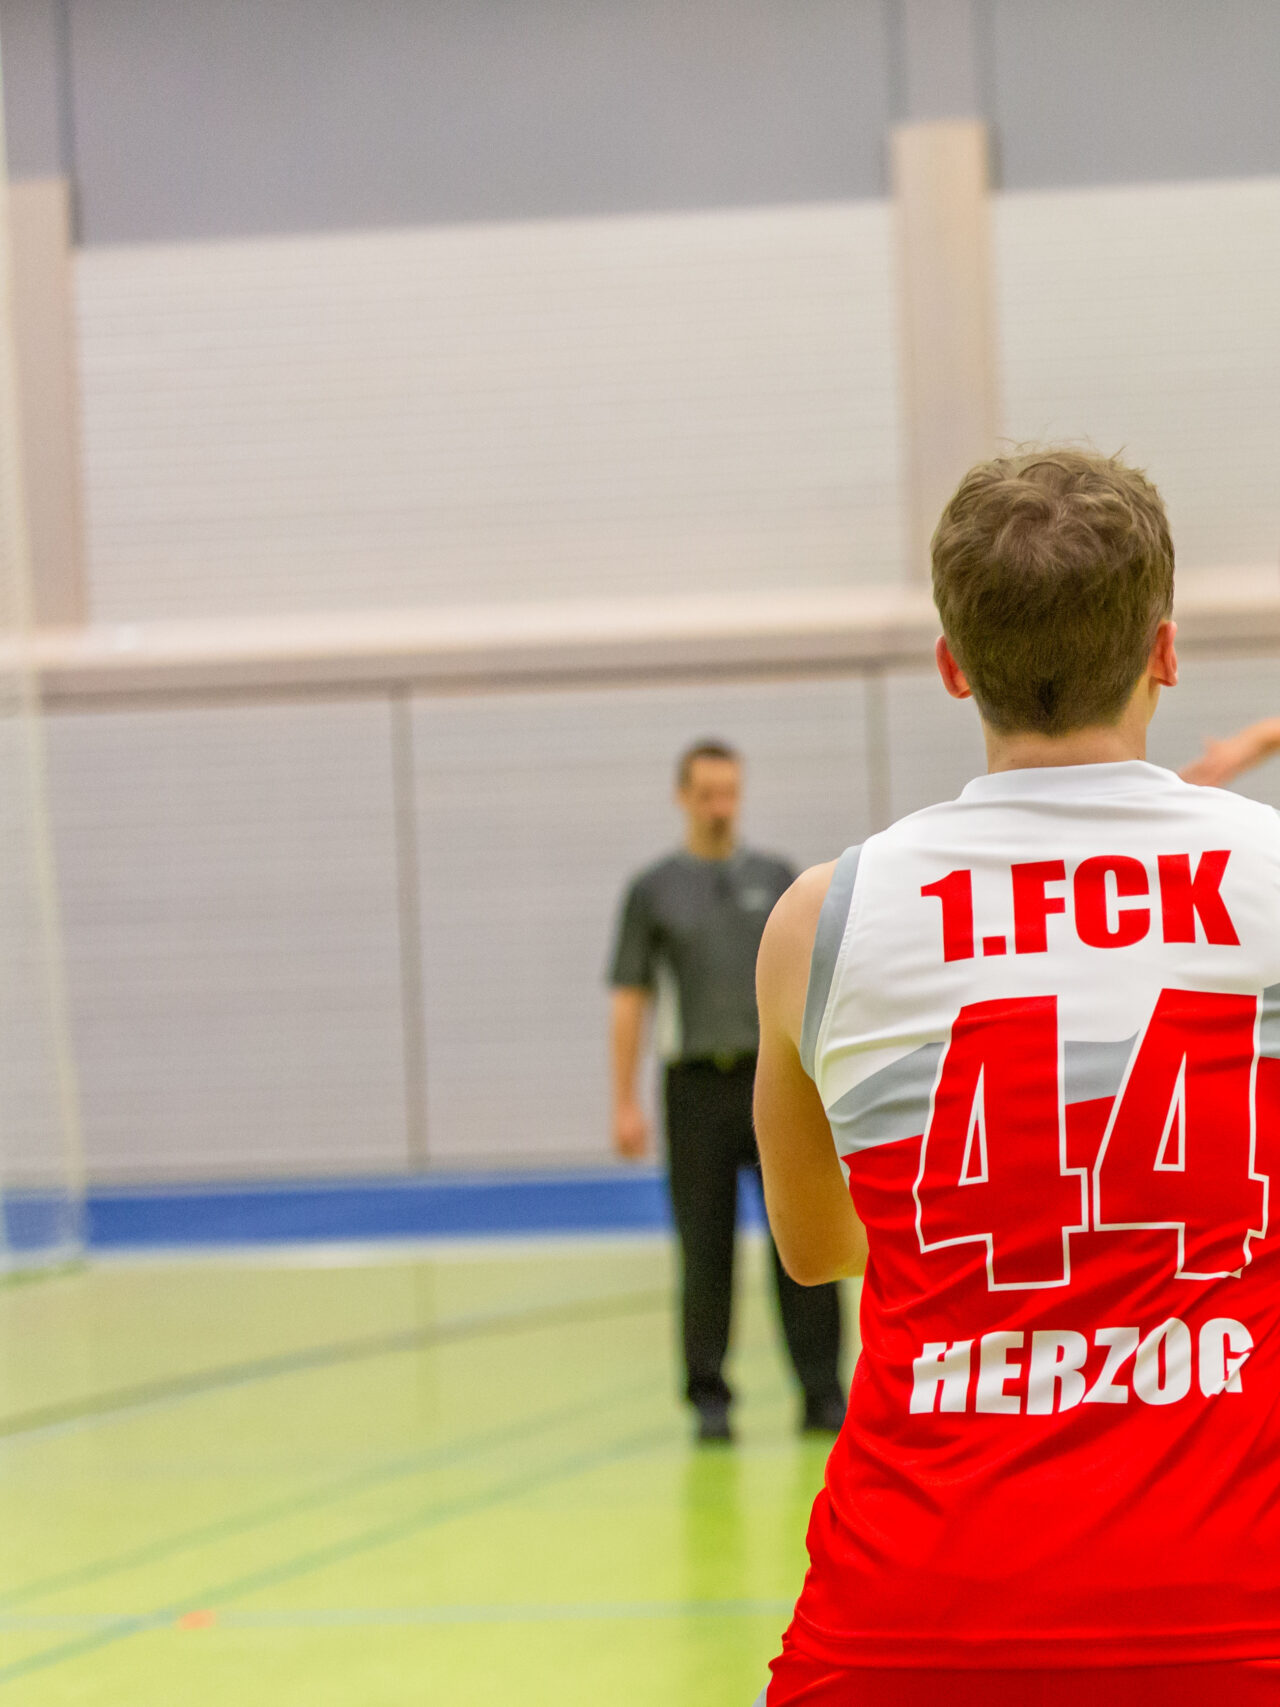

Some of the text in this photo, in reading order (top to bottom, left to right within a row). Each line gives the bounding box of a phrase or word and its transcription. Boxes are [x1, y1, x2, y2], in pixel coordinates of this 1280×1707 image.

[920, 849, 1241, 963] 1.FCK
[912, 987, 1270, 1292] 44
[909, 1317, 1255, 1416] HERZOG
